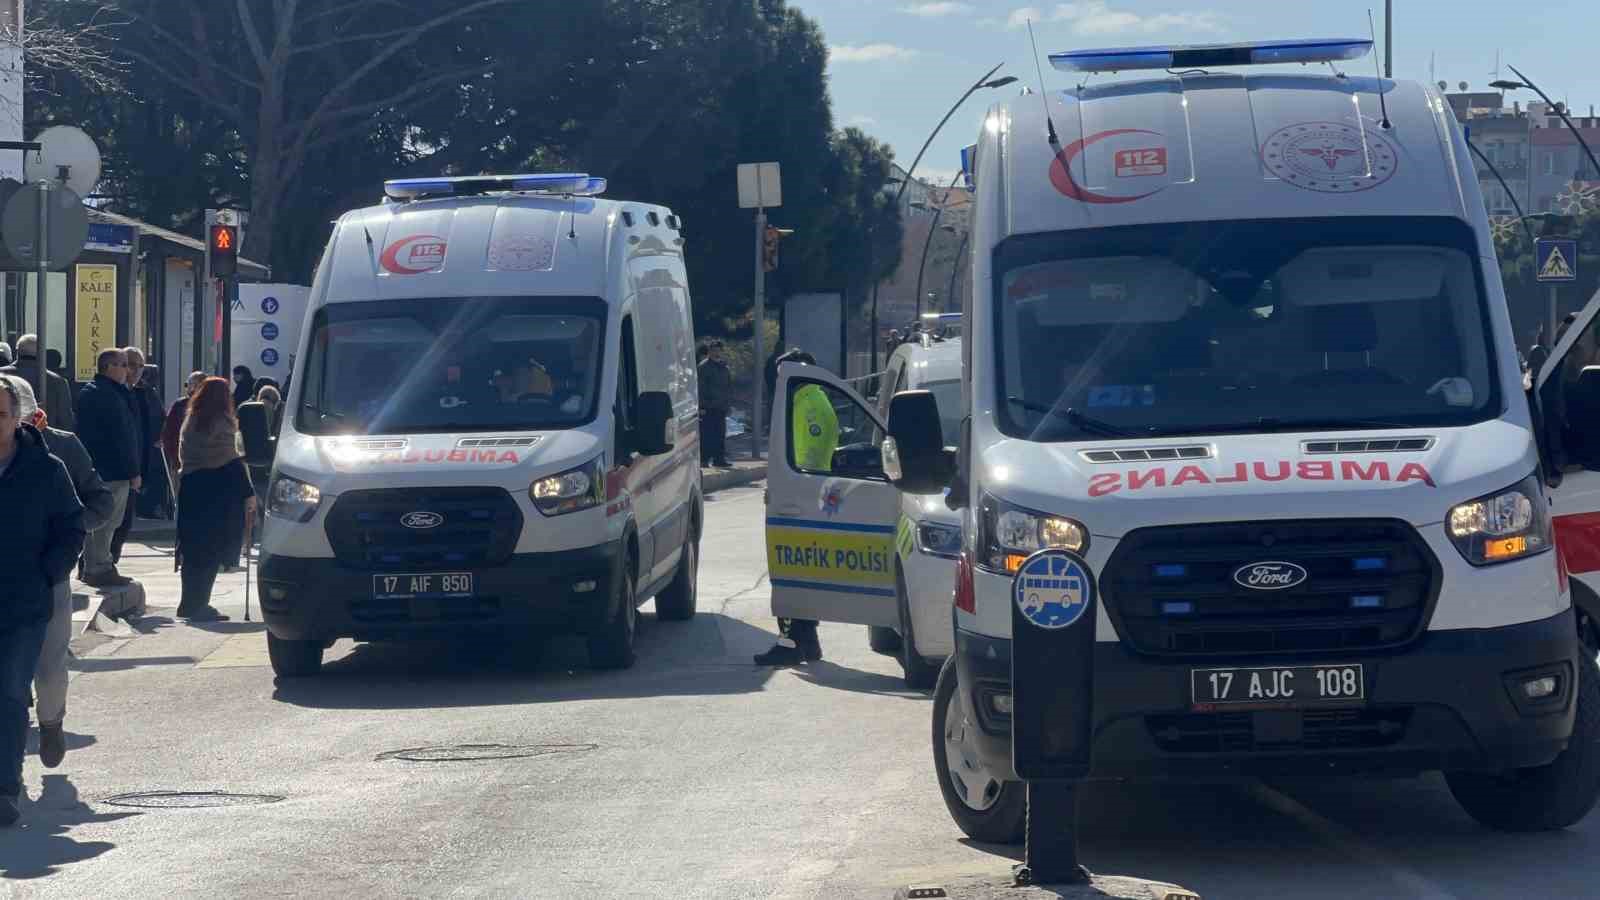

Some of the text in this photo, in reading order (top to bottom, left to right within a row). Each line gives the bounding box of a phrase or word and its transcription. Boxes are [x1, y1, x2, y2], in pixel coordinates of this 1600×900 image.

[1122, 151, 1160, 165] 112
[416, 244, 441, 256] 112
[80, 282, 112, 293] KALE
[1248, 565, 1292, 584] Ford
[383, 575, 469, 593] 17 AIF 850
[1209, 669, 1357, 699] 17 AJC 108
